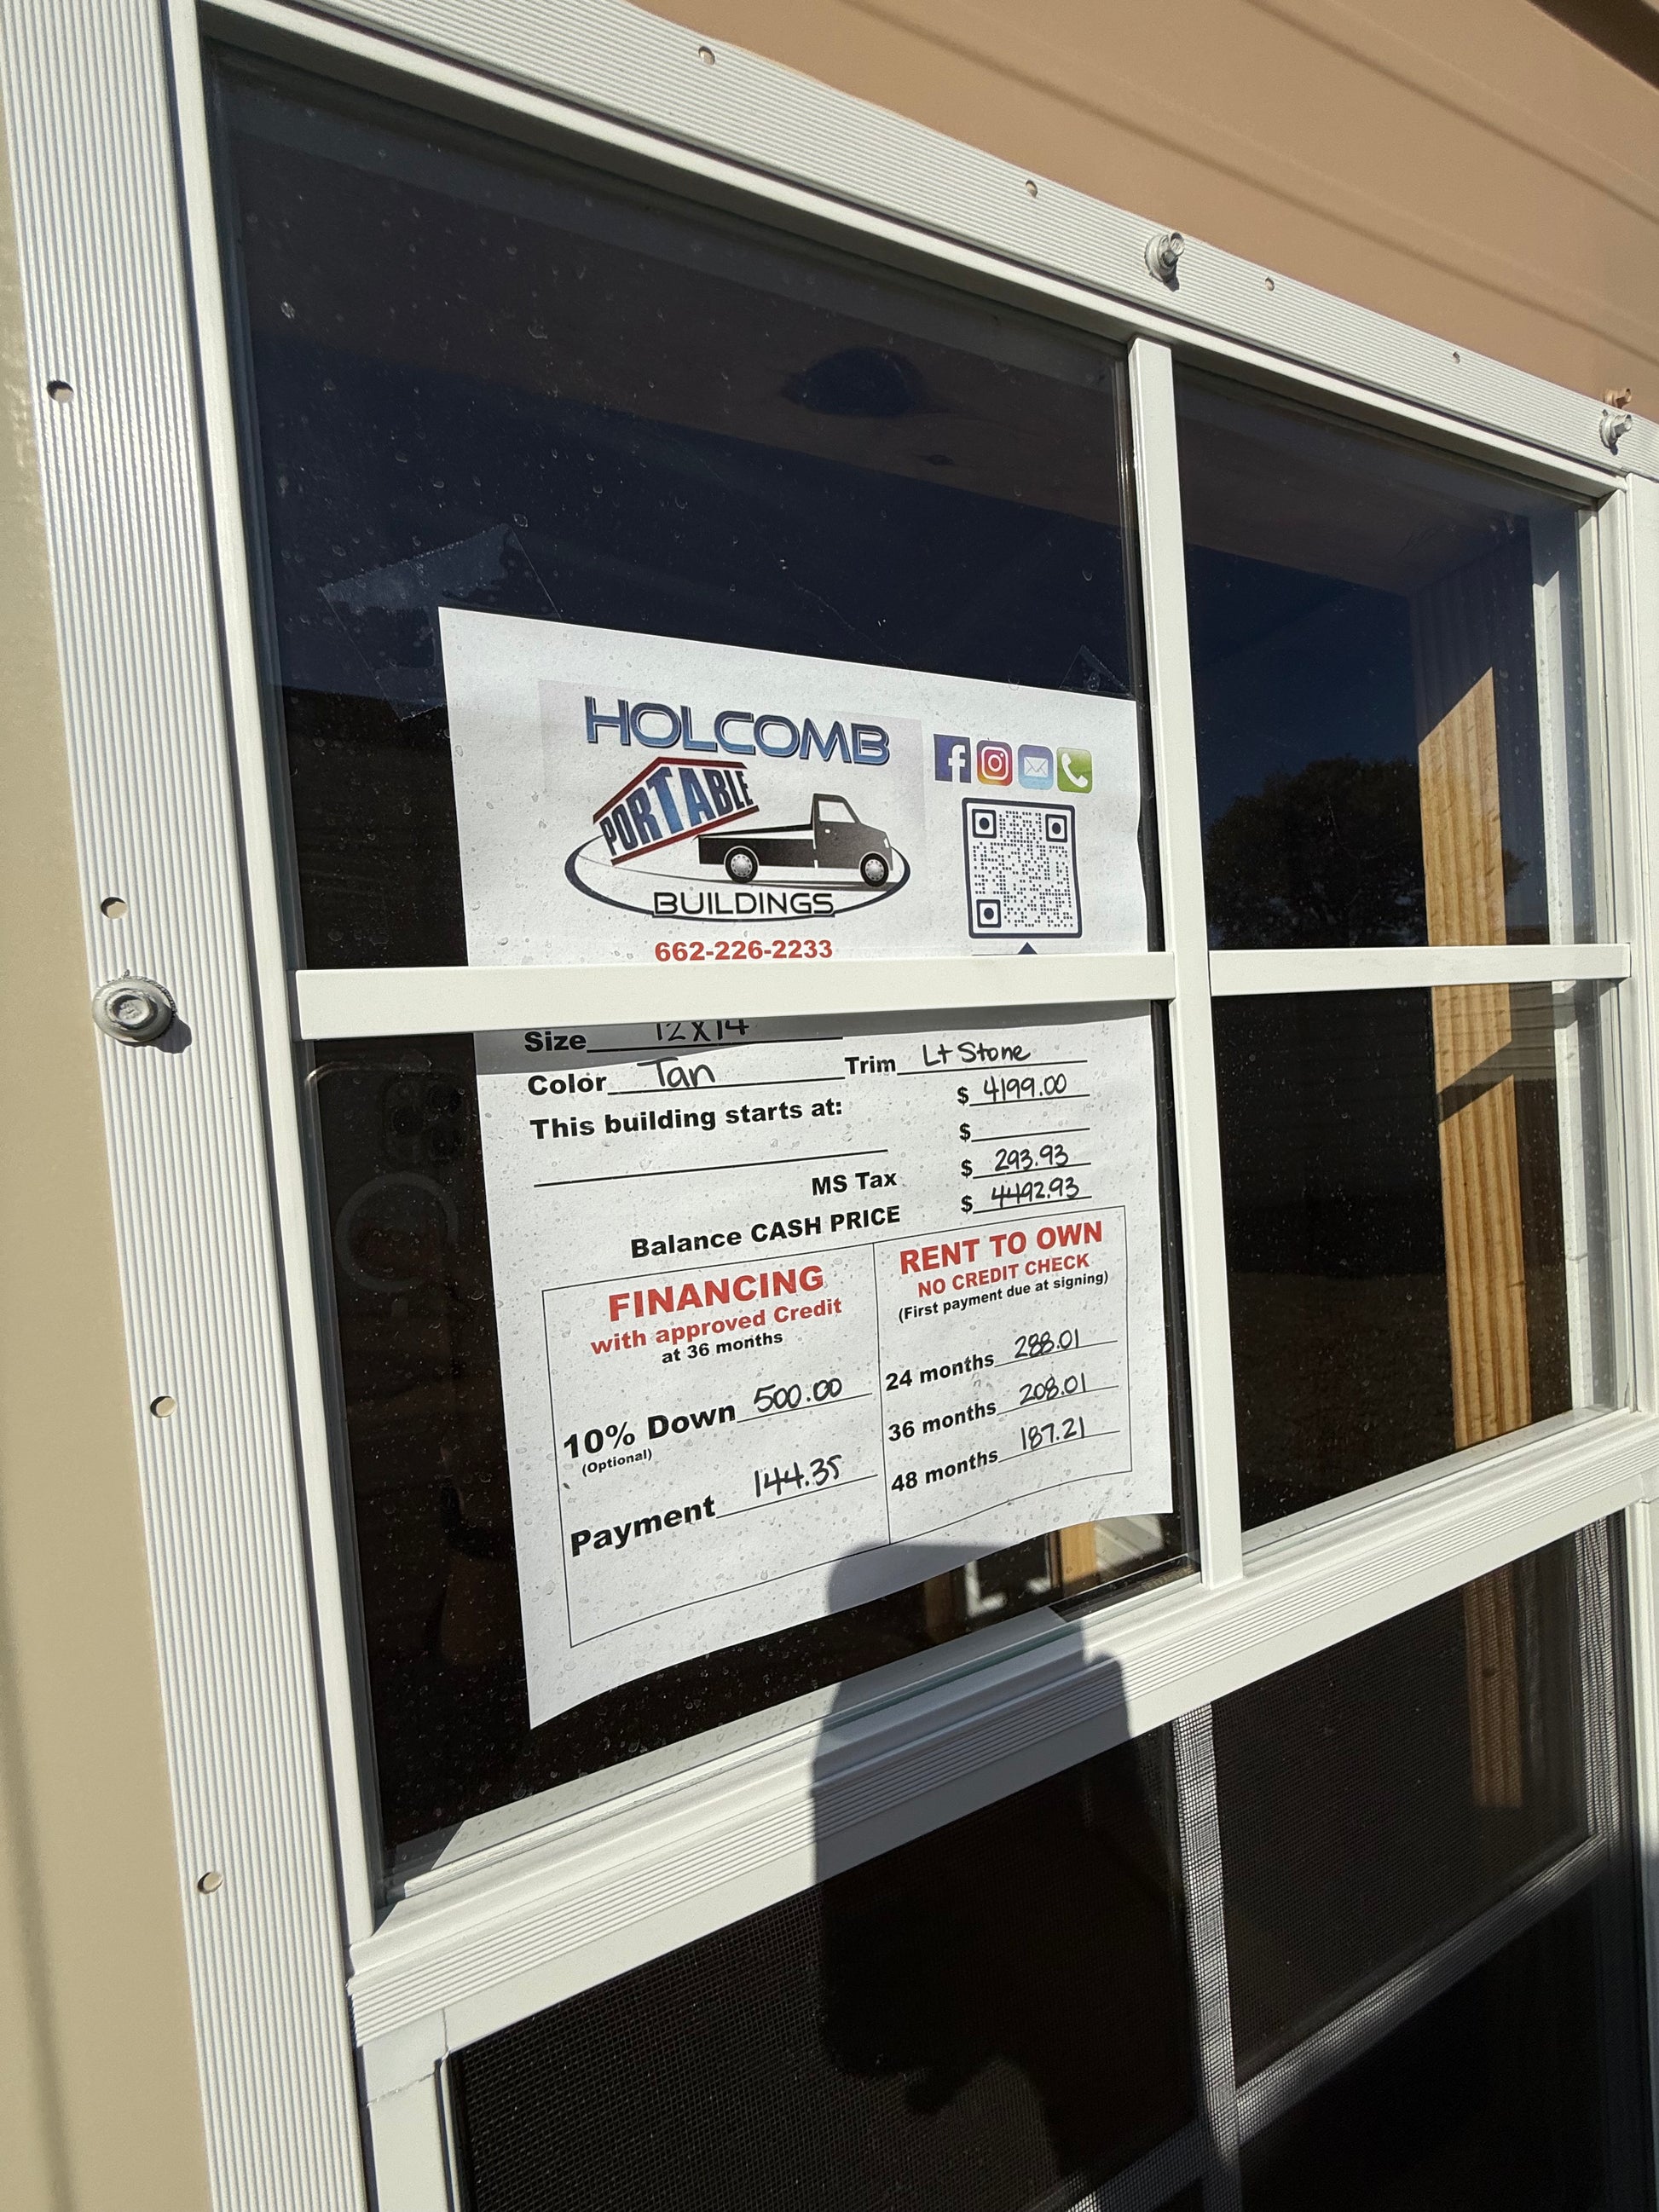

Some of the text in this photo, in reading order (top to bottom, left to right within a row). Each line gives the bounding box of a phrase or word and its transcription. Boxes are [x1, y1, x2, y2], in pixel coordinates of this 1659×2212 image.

[585, 696, 890, 765] HOLCOMB
[599, 766, 754, 856] PORTABLE
[654, 892, 834, 915] BUILDINGS
[655, 940, 833, 962] 662-226-2233
[524, 1031, 587, 1052] Size
[957, 1042, 1032, 1063] Stone
[637, 1056, 716, 1088] Tan
[845, 1056, 896, 1074] Trim
[528, 1073, 607, 1095] Color
[957, 1086, 969, 1106] $
[984, 1073, 1067, 1102] 4199.00
[530, 1098, 842, 1139] This building starts at:
[959, 1123, 971, 1142] $
[961, 1158, 973, 1179] $
[994, 1144, 1069, 1171] 293.93
[812, 1171, 898, 1196] MS Tax
[991, 1176, 1080, 1209] 4492.93
[961, 1194, 973, 1215] $
[631, 1205, 900, 1259] Balance CASH PRICE
[899, 1221, 1103, 1275] RENT TO OWN
[917, 1253, 1090, 1298] NO CREDIT CHECK
[609, 1265, 824, 1322] FINANCING
[898, 1270, 1109, 1323] (First payment due at signing)
[590, 1297, 842, 1355] with approved Credit
[662, 1331, 783, 1364] at 36 months
[1014, 1328, 1079, 1359] 288.01
[885, 1352, 994, 1391] 24 months
[753, 1377, 843, 1413] 500.00
[1019, 1372, 1087, 1405] 208.01
[564, 1402, 737, 1459] 10% Down
[887, 1401, 997, 1441] 36 months
[1020, 1417, 1085, 1451] 187.21
[581, 1448, 653, 1477] (Optional)
[754, 1454, 842, 1498] 144.35
[891, 1448, 998, 1493] 48 months
[570, 1494, 716, 1557] Payment
